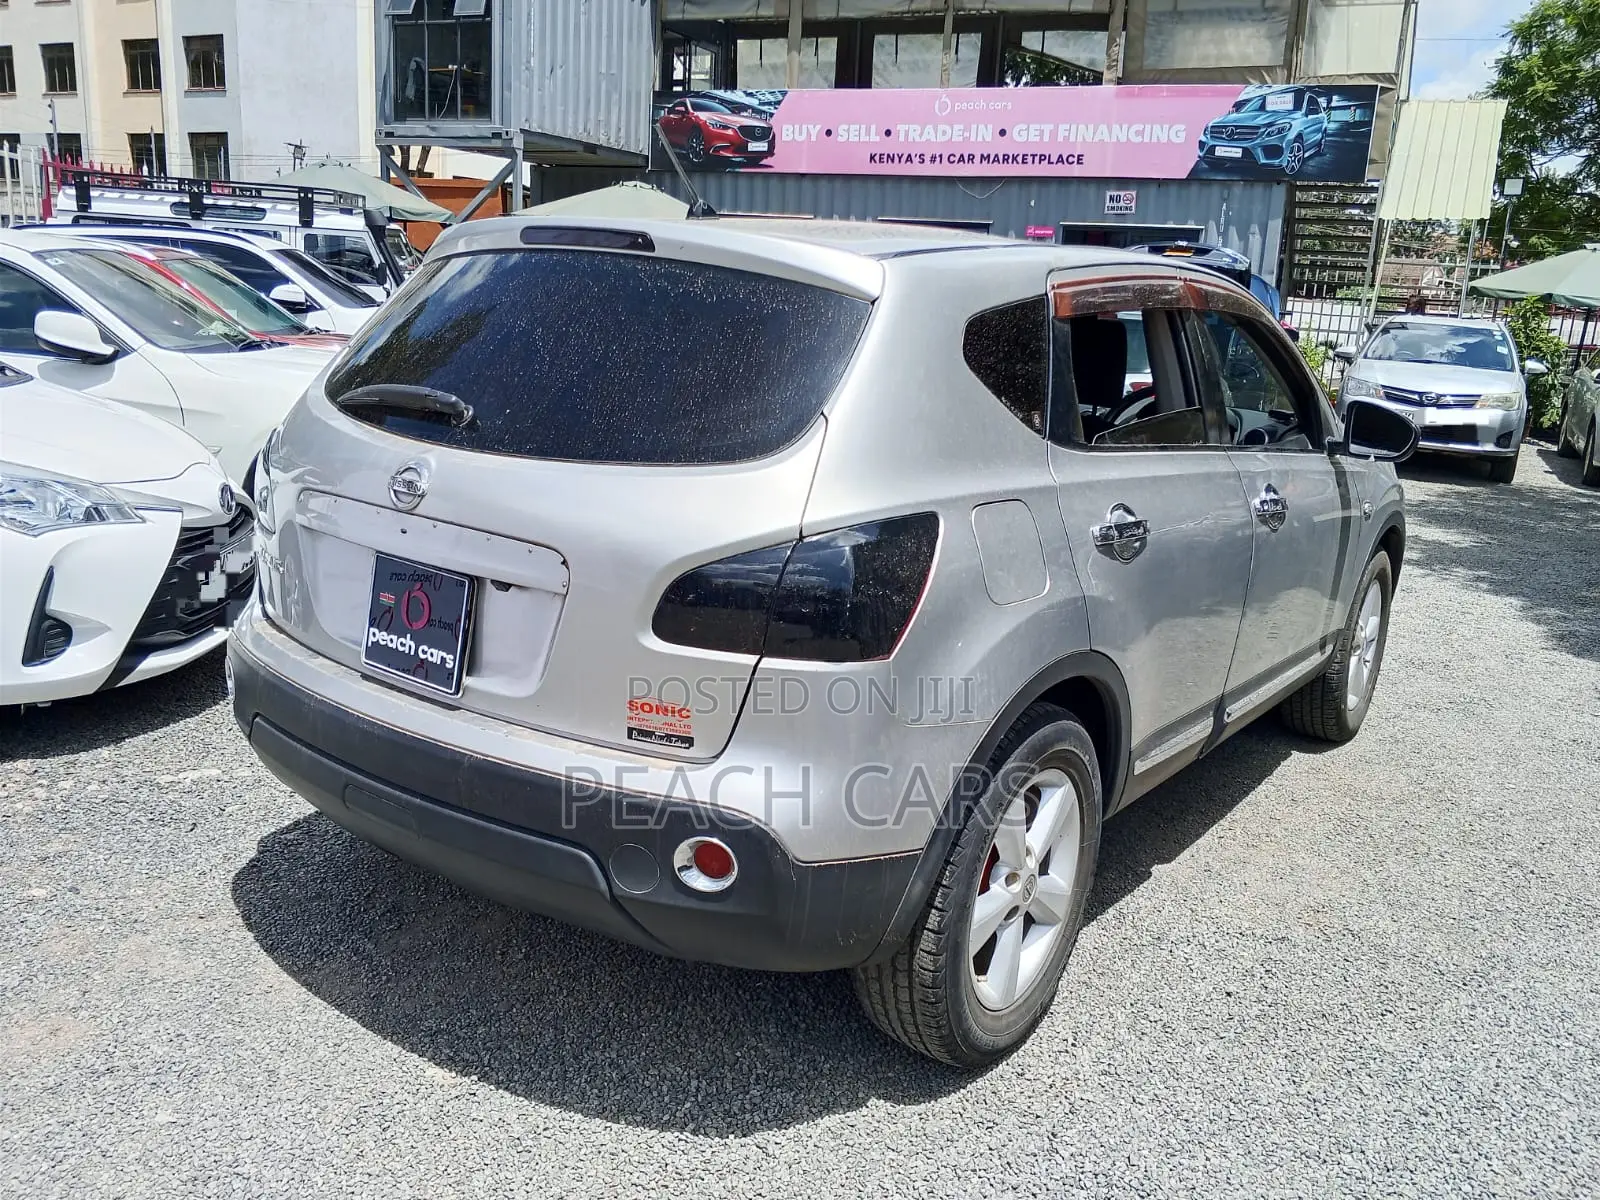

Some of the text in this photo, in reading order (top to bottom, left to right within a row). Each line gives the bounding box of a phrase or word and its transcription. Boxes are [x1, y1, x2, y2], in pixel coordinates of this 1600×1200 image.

[954, 98, 1012, 113] peach cars
[781, 123, 1187, 143] BUY SELL TRADE-IN GET FINANCING
[869, 152, 1085, 165] KENYA'S #1 CAR MARKETPLACE
[1108, 194, 1122, 204] NO
[367, 627, 416, 655] peach
[417, 644, 455, 669] cars
[627, 699, 692, 719] SONIC
